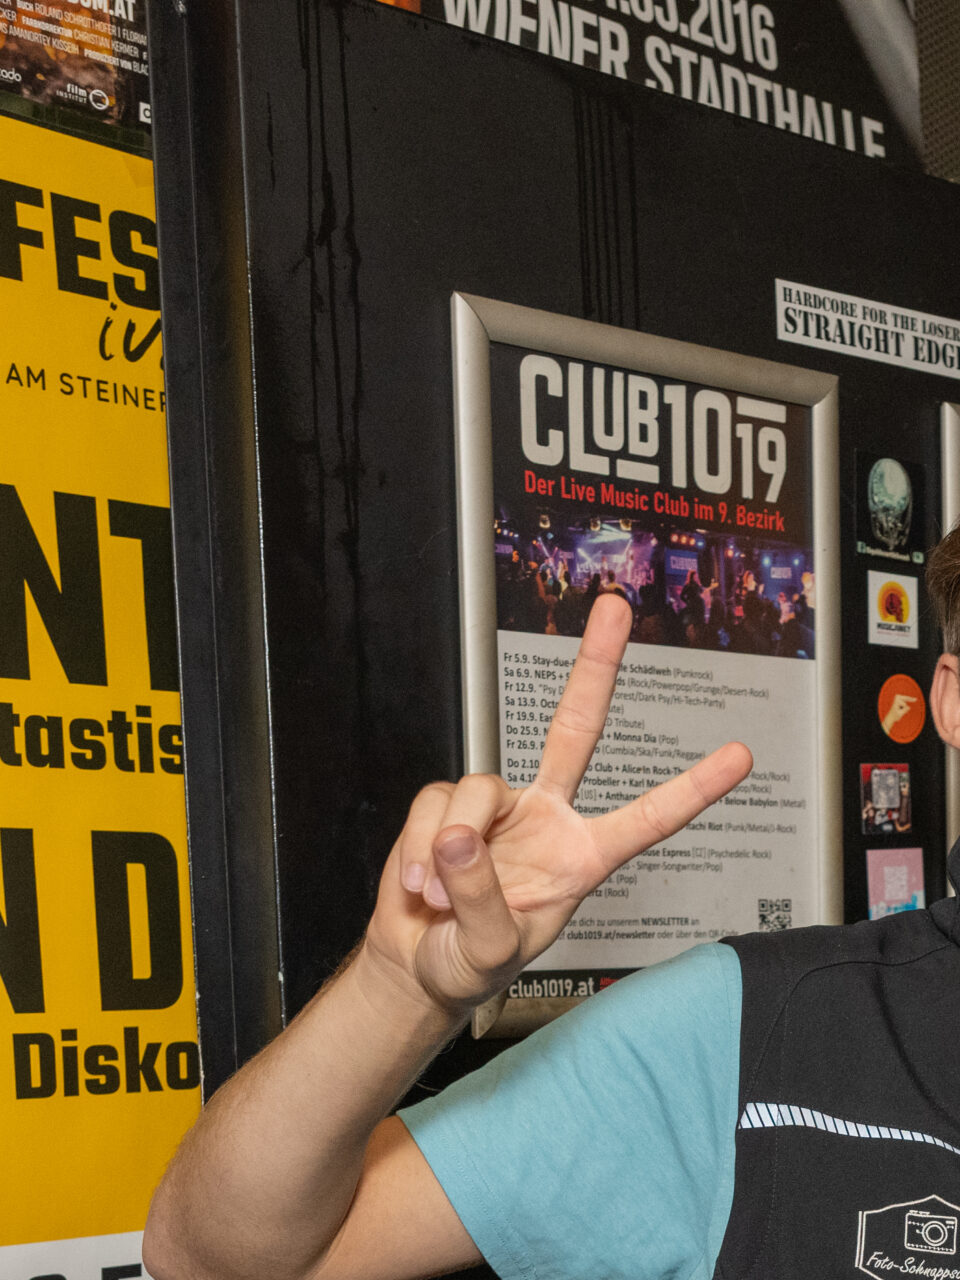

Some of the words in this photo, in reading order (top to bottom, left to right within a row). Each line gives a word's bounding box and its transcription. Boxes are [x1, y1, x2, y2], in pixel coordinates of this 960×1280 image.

[35, 3, 63, 21] ROLAND
[67, 83, 87, 97] film
[782, 286, 858, 319] HARDCORE
[862, 305, 888, 325] FOR
[891, 312, 918, 332] THE
[784, 306, 906, 358] STRAIGHT
[6, 362, 46, 391] AM
[524, 470, 553, 496] Der
[560, 476, 596, 503] Live
[600, 483, 649, 511] Music
[654, 490, 690, 517] Club
[693, 497, 714, 522] im
[718, 502, 732, 524] 9.
[736, 505, 785, 531] Bezirk
[504, 652, 512, 660] Fr
[514, 653, 530, 664] 5.9.
[504, 667, 514, 677] Sa
[516, 668, 532, 678] 6.9.
[534, 669, 557, 680] NEPS
[673, 668, 713, 681] (Punkrock)
[505, 681, 513, 691] Fr
[516, 682, 536, 693] 12.9.
[505, 696, 515, 705] Sa
[518, 697, 538, 707] 13.9.
[613, 691, 656, 703] orest/Dark
[506, 710, 514, 719] Fr
[517, 711, 537, 721] 19.9.
[615, 719, 645, 730] Tribute)
[506, 725, 518, 735] Do
[520, 726, 541, 736] 25.9.
[613, 732, 641, 742] Monna
[659, 735, 679, 745] (Pop)
[507, 740, 515, 749] Fr
[517, 740, 538, 750] 26.9.
[507, 758, 519, 768] Do
[595, 763, 613, 773] Club
[621, 764, 641, 774] Alice
[507, 772, 517, 782] Sa
[629, 778, 645, 788] Karl
[749, 798, 778, 809] Babylon
[574, 803, 610, 816] rbaumer
[708, 822, 723, 832] Riot
[662, 849, 691, 859] Express
[636, 861, 723, 873] Singer-Songwriter/Pop)
[616, 874, 637, 885] (Pop)
[604, 888, 629, 898] (Rock)
[579, 917, 595, 927] dich
[597, 919, 605, 927] zu
[641, 917, 690, 926] NEWSLETTER
[567, 931, 655, 941] club1019.at/newsletter
[657, 931, 674, 939] oder
[675, 930, 692, 939] über
[693, 930, 707, 939] den
[509, 977, 595, 998] club1019.at
[12, 1026, 201, 1100] Disko
